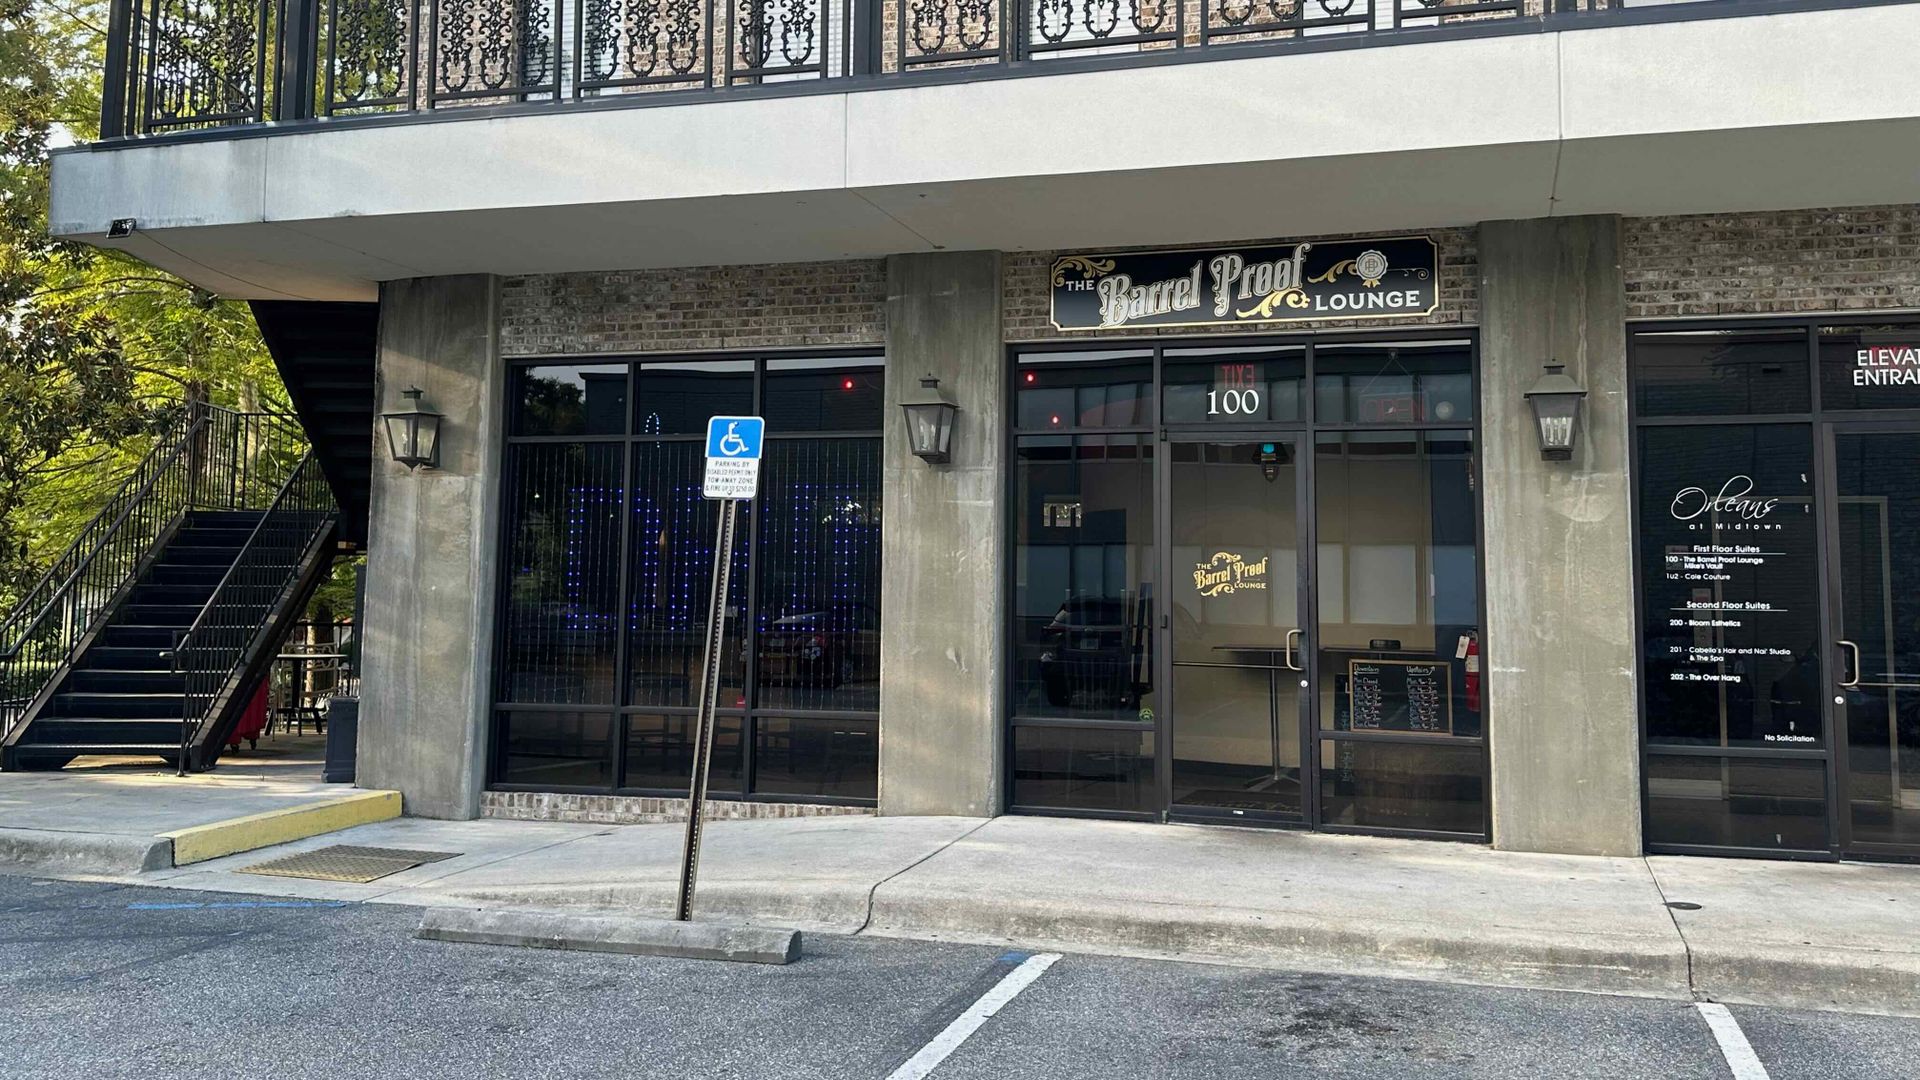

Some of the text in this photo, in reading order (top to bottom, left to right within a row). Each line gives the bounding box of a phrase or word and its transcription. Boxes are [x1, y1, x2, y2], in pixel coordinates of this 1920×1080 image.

[1065, 279, 1096, 292] THE
[1097, 260, 1204, 329] Barrel
[1208, 242, 1313, 318] Proof
[1314, 290, 1421, 312] LOUNGE
[1853, 368, 1920, 386] ENTRA
[1207, 389, 1260, 415] 100
[706, 468, 728, 476] DISABLED
[738, 476, 753, 484] ZONE
[1670, 474, 1779, 520] Orleans
[1693, 545, 1710, 553] First
[1711, 545, 1734, 553] Floor
[1697, 556, 1717, 564] Barrel
[1718, 556, 1736, 564] Proof
[1737, 557, 1764, 565] Lounge
[1193, 564, 1231, 590] Barrel
[1233, 556, 1269, 584] Proof
[1686, 601, 1771, 610] Second Floor Suites
[1669, 619, 1683, 627] 200
[1688, 619, 1711, 627] Bloom
[1711, 620, 1741, 628] Esthetics
[1722, 647, 1737, 655] Hair
[1769, 648, 1791, 656] Studio
[1710, 655, 1725, 663] Spa
[1670, 673, 1684, 681] 202
[1702, 674, 1720, 682] Over
[1721, 674, 1741, 683] Hang
[1764, 734, 1815, 743] No Solicitation
